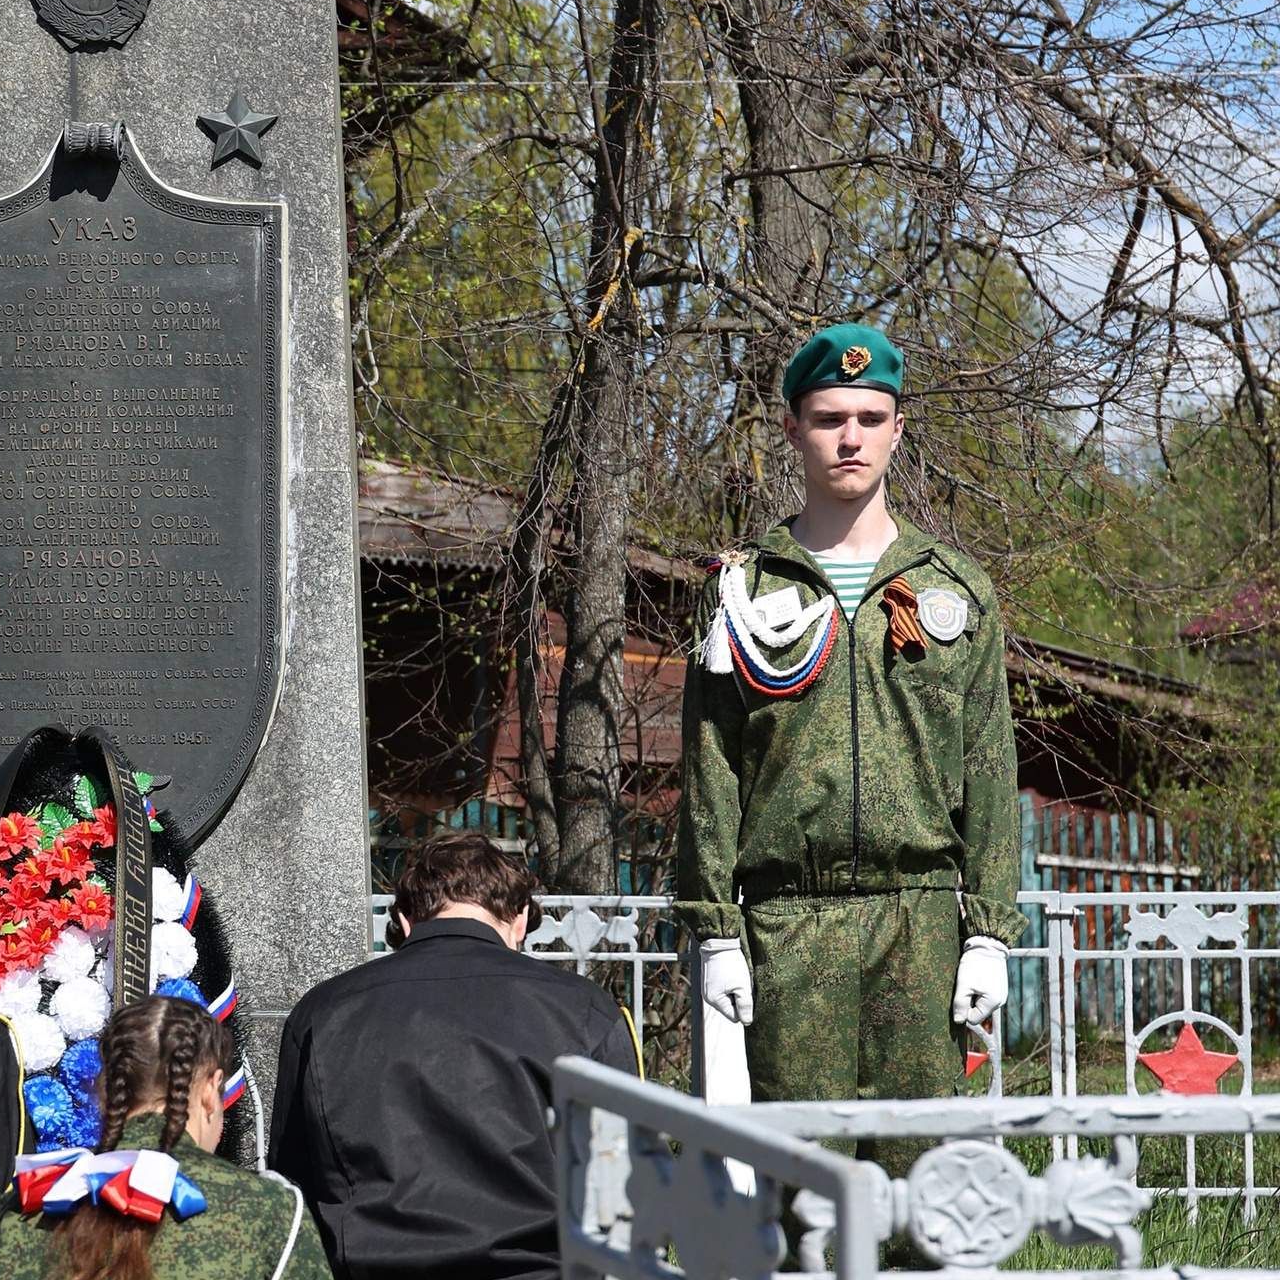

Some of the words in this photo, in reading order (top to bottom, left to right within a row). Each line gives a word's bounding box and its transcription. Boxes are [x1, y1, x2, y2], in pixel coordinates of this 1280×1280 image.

[49, 217, 139, 246] УКАЗ
[66, 269, 120, 284] СССР
[25, 287, 37, 299] О
[44, 286, 160, 300] НАГРАЖДЕНИИ
[150, 319, 221, 332] АВИАЦИИ
[15, 335, 127, 352] РЯЗАНОВА
[11, 354, 87, 368] МЕДАЛЬЮ
[0, 388, 103, 404] ОБРАЗЦОВОЕ
[113, 388, 220, 402] ВЫПОЛНЕНИЕ
[27, 402, 100, 419] ЗАДАНИЙ
[106, 404, 234, 419] КОМАНДОВАНИЯ
[8, 422, 29, 435] НА
[39, 421, 102, 435] ФРОНТЕ
[111, 421, 179, 434] БОРЬБЫ
[92, 437, 218, 451] ЗАХВАТЧИКАМИ
[25, 454, 98, 468] ДАЮЩЕЕ
[108, 453, 161, 466] ПРАВО
[25, 469, 122, 484] ПОЛУЧЕНИЕ
[129, 468, 190, 482] ЗВАНИЯ
[46, 502, 137, 516] НАГРАДИТЬ
[150, 531, 220, 546] АВИАЦИИ
[22, 549, 160, 569] РЯЗАНОВА
[71, 571, 222, 588] ГЕОРГИЕВИЧА
[10, 591, 87, 605] МЕДАЛЬЮ
[63, 605, 156, 621] БРОНЗОВЫЙ
[163, 606, 211, 620] БЮСТ
[217, 607, 229, 620] И
[63, 623, 92, 637] ЕГО
[99, 623, 119, 636] НА
[127, 622, 235, 636] ПОСТАМЕНТЕ
[3, 640, 63, 654] РОДИНЕ
[70, 638, 215, 653] НАГРАЖДЕННОГО.
